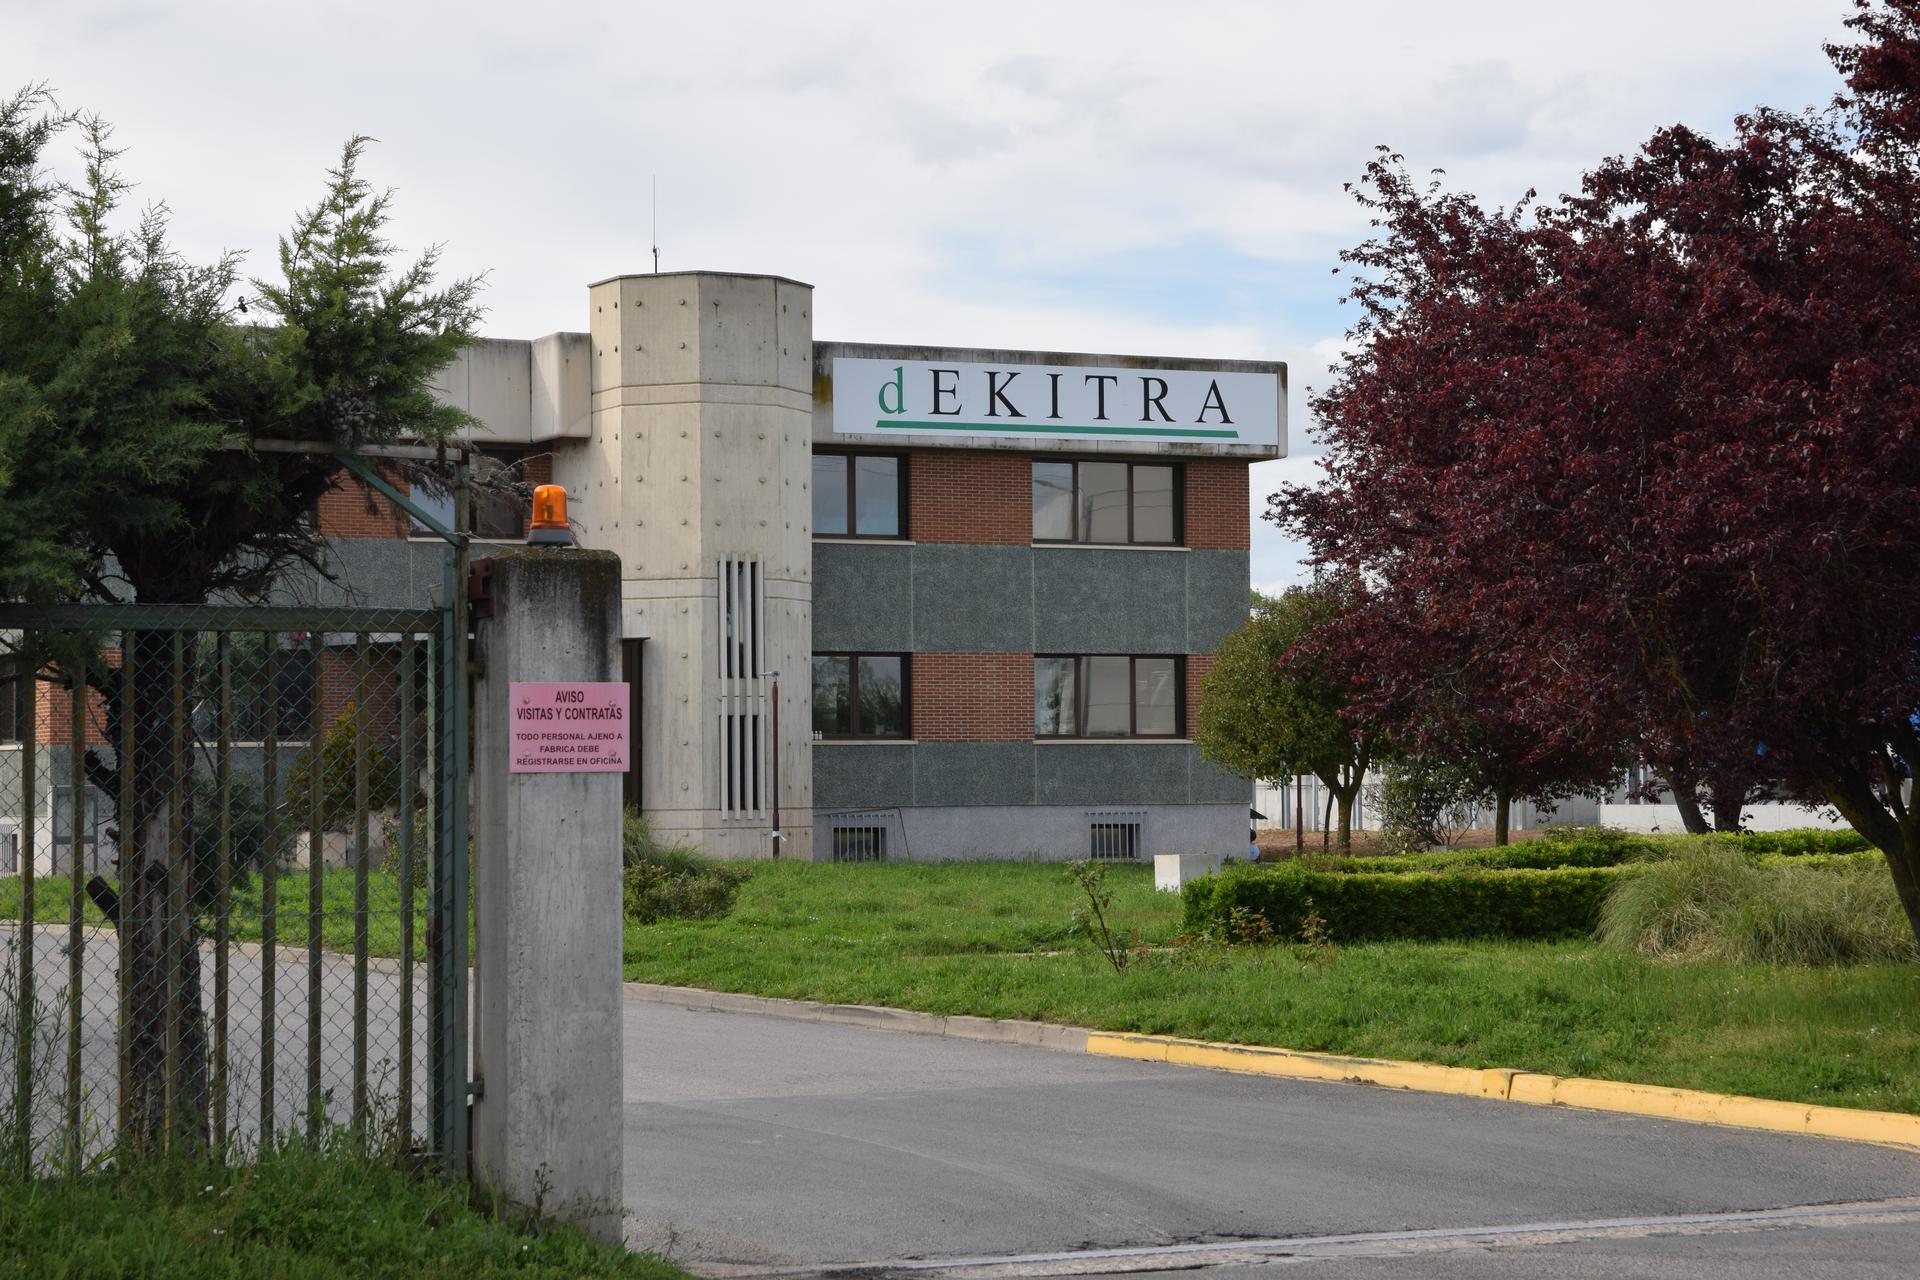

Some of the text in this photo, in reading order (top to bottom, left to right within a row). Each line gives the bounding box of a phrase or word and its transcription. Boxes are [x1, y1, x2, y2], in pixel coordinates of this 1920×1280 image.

[555, 690, 585, 703] AVISO
[516, 707, 623, 720] VISITAS Y CONTRATAS
[516, 733, 539, 741] TODO
[539, 745, 600, 753] FABRICA DEBE
[516, 757, 622, 766] REGISTRARSE EN OFICINA
